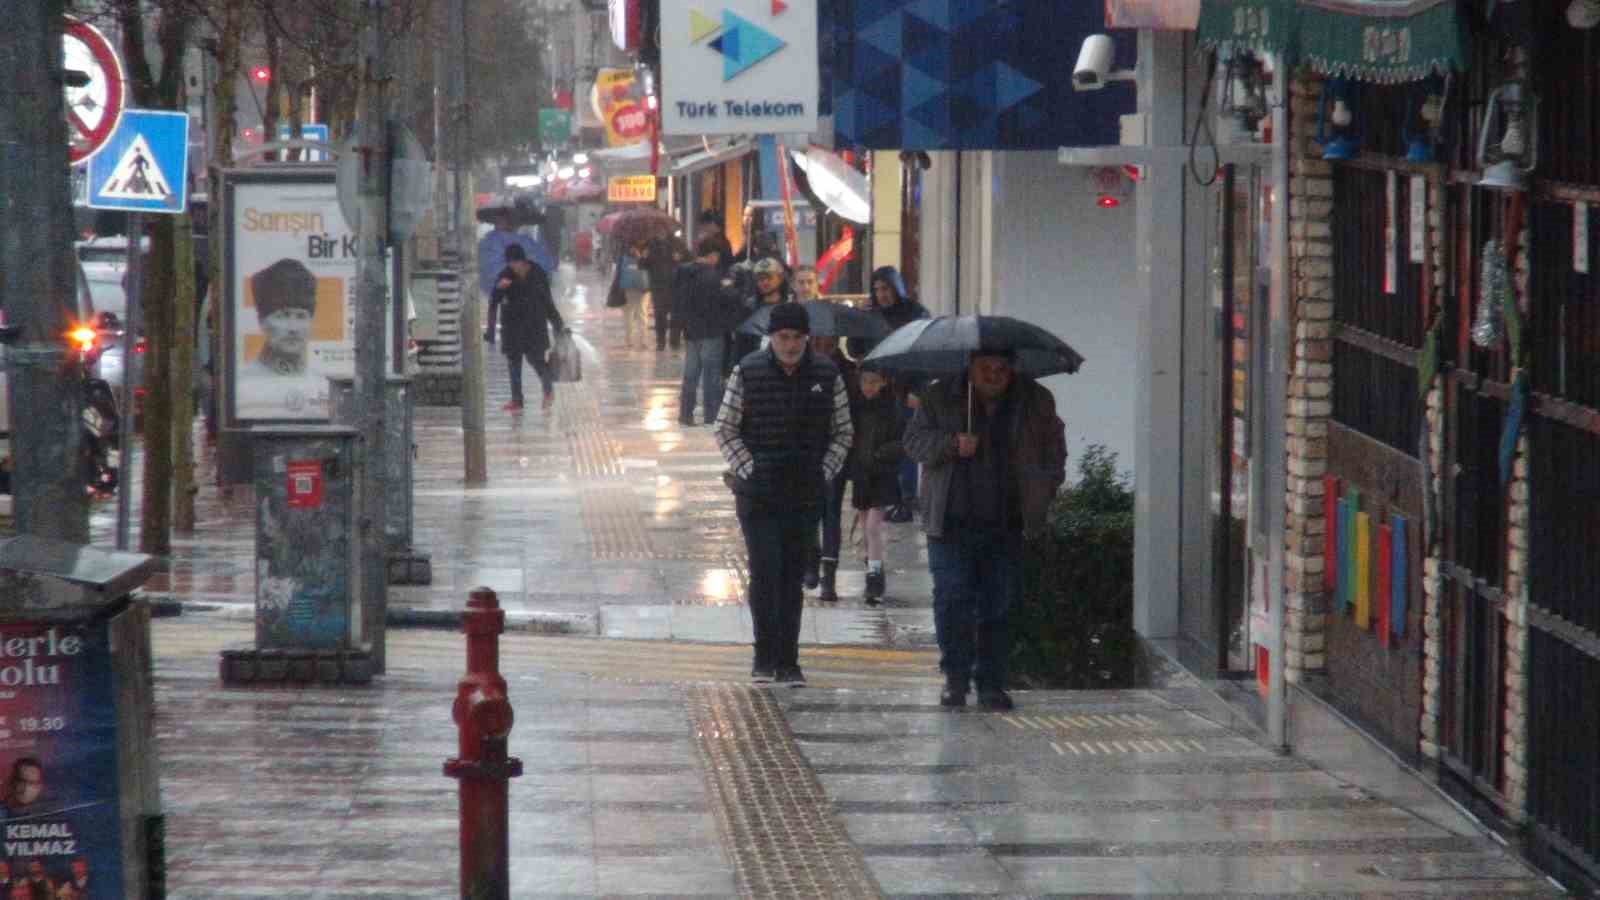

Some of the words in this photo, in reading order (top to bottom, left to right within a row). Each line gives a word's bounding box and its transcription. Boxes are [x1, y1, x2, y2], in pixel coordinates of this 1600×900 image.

[676, 100, 717, 118] Türk
[723, 100, 804, 117] Telekom
[308, 233, 337, 258] Bir
[19, 717, 65, 732] 19.30
[6, 823, 73, 839] KEMAL
[4, 840, 77, 856] YILMAZ
